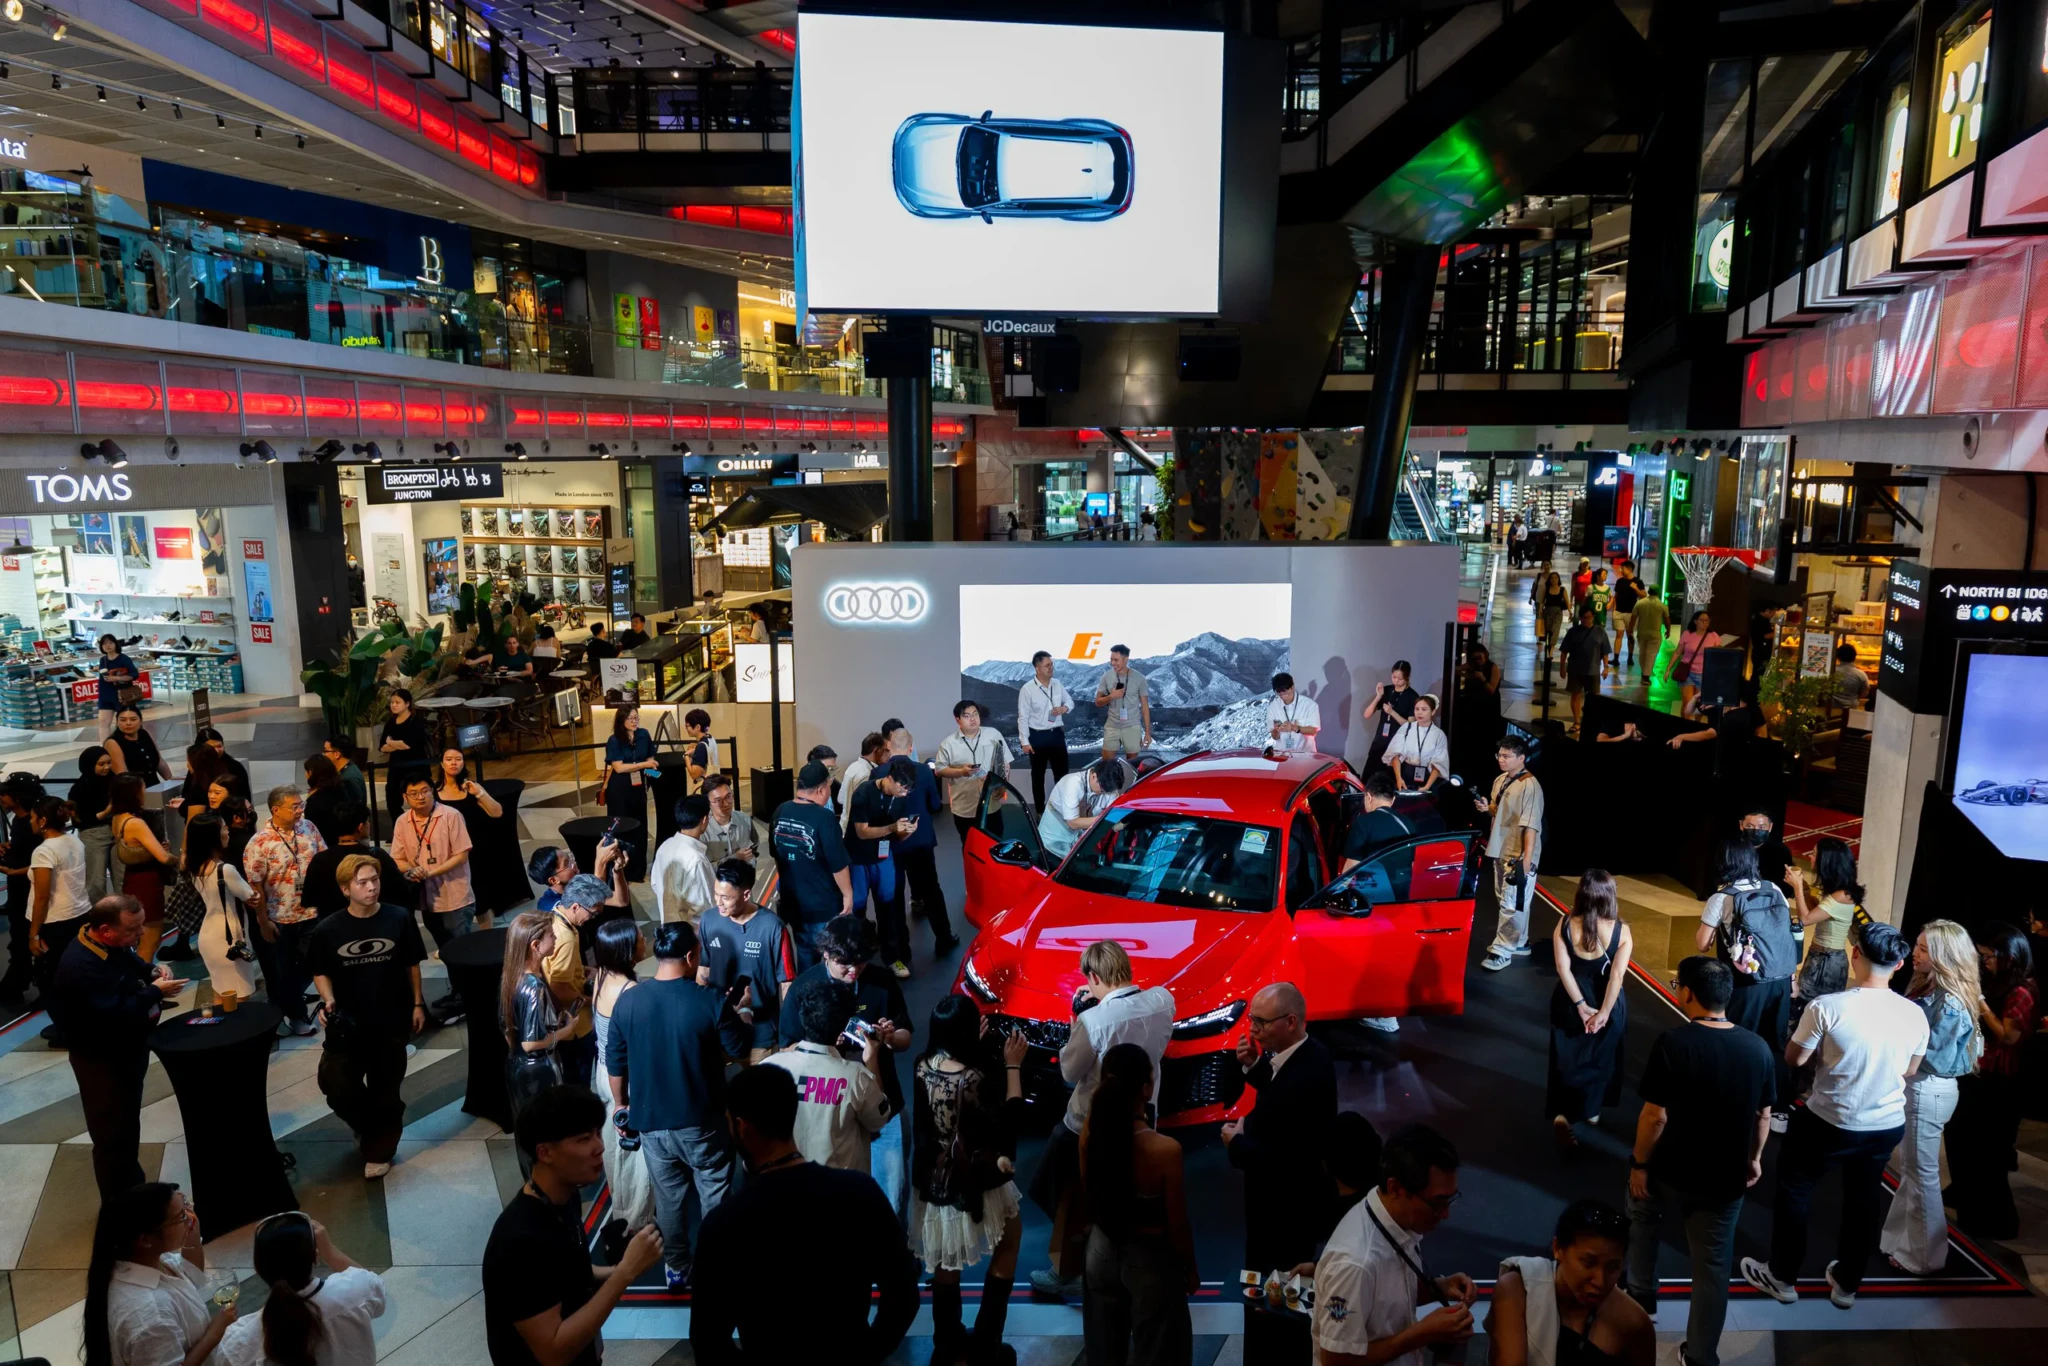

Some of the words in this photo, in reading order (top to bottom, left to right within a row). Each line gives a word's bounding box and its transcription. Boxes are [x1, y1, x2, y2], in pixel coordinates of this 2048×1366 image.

[0, 138, 27, 159] ta
[983, 320, 1056, 333] JCDecaux
[387, 473, 436, 485] BROMPTON
[26, 473, 132, 503] TOMS
[394, 489, 432, 500] JUNCTION
[245, 543, 262, 555] SALE
[1959, 586, 2003, 598] NORTH
[2006, 587, 2048, 600] BIDG
[253, 627, 271, 639] SALE
[609, 664, 628, 673] $29
[75, 683, 99, 698] SALE
[342, 955, 392, 966] SALOMON
[803, 1076, 848, 1106] PMC
